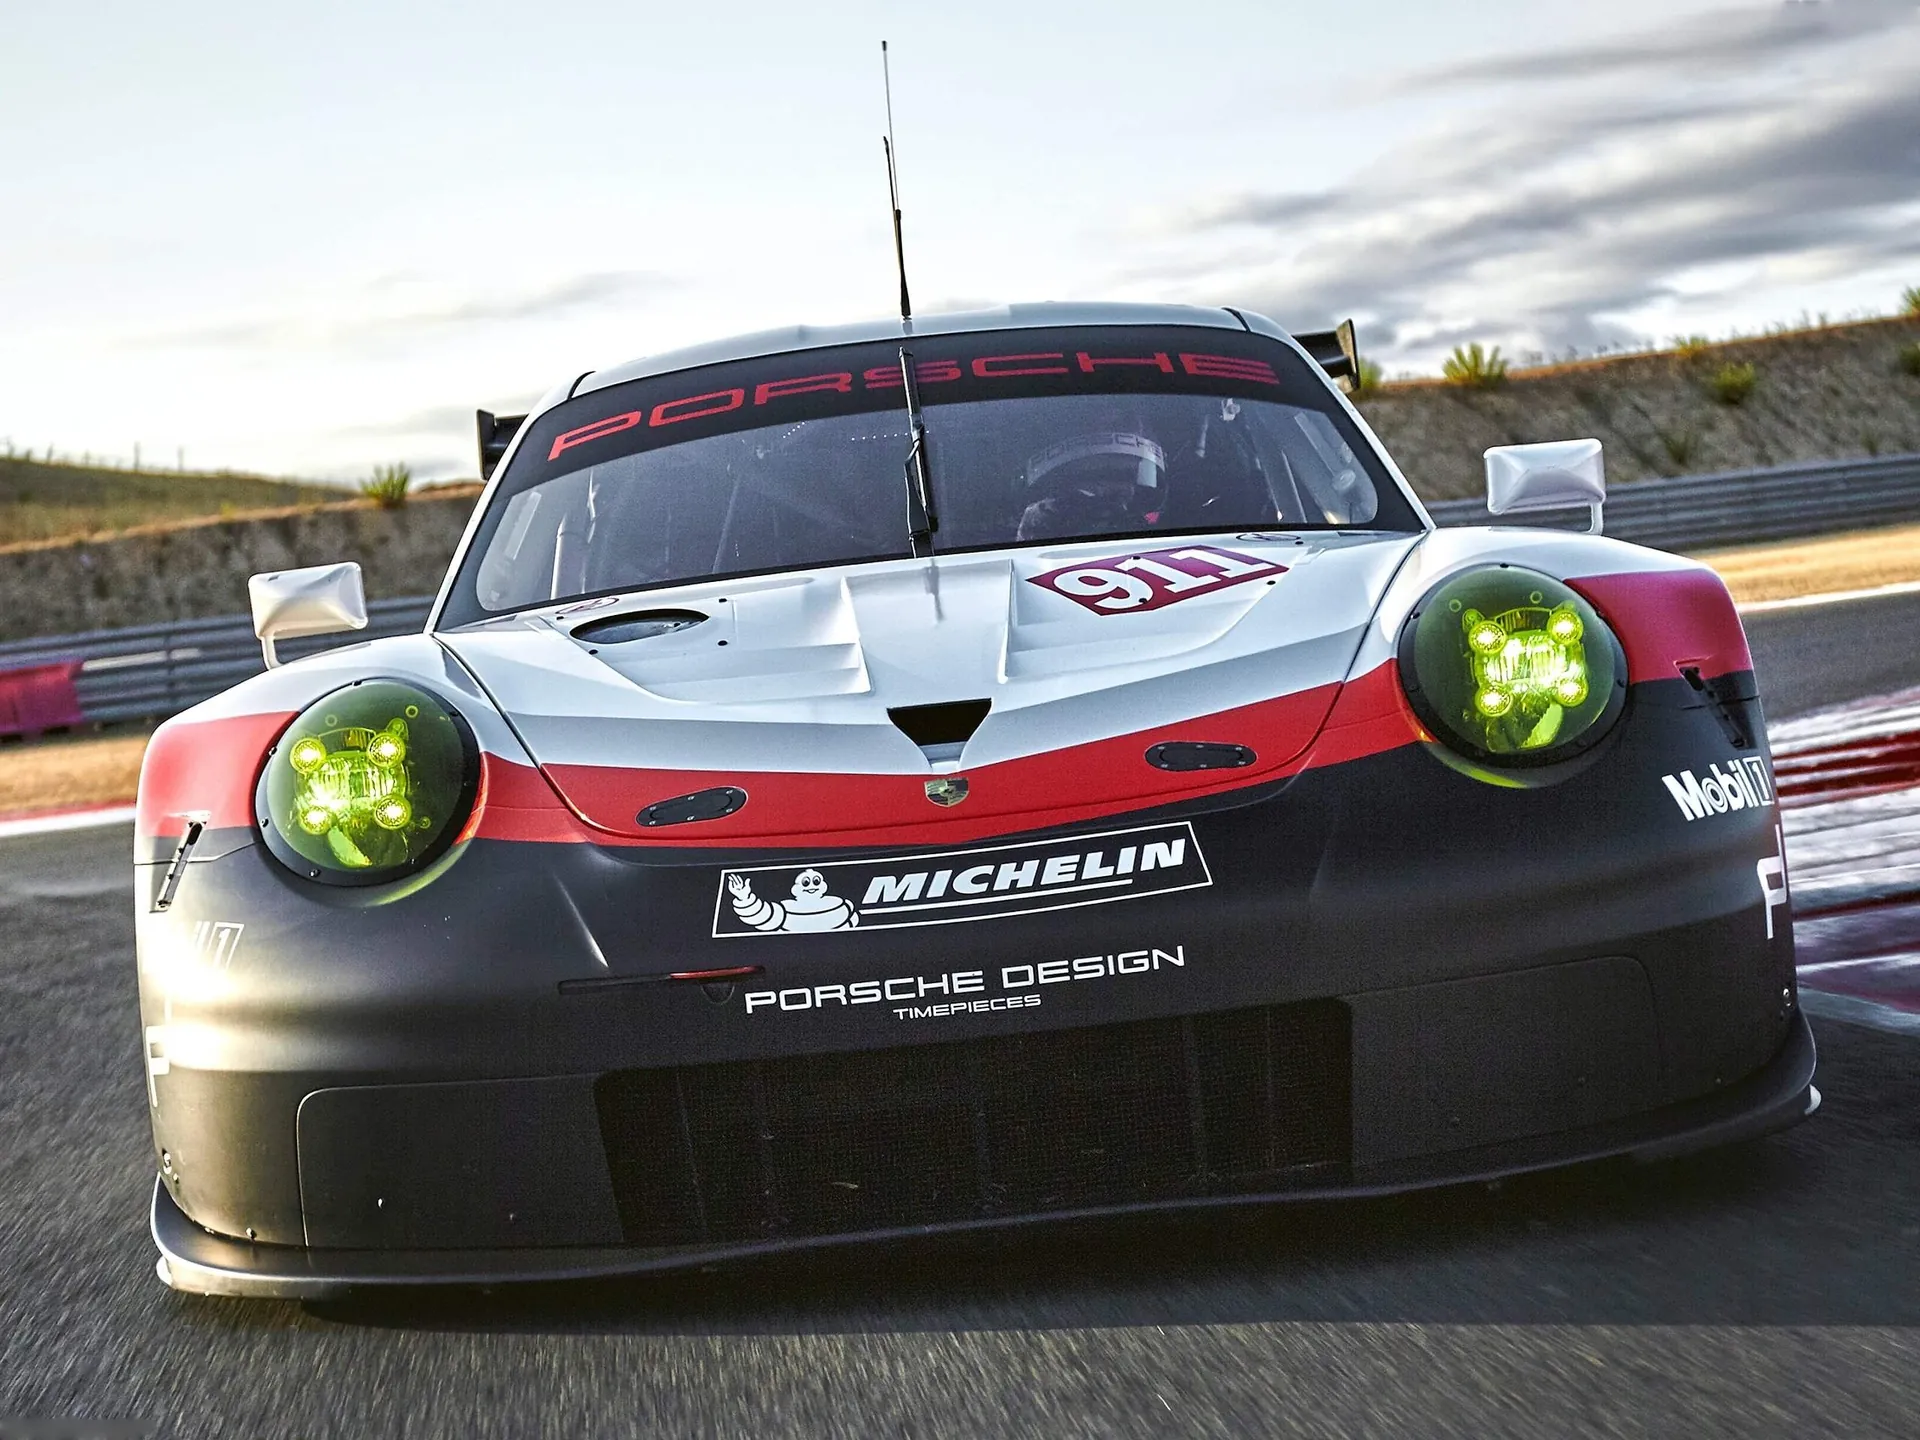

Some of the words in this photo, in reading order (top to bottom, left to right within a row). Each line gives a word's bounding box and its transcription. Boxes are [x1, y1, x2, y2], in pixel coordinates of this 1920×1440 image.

[548, 351, 1280, 460] PORSCHE
[1053, 549, 1274, 609] 911
[862, 838, 1186, 904] MICHELIN
[744, 970, 985, 1014] PORSCHE
[1001, 945, 1186, 989] DESIGN
[892, 993, 1042, 1020] TIMEPIECES
